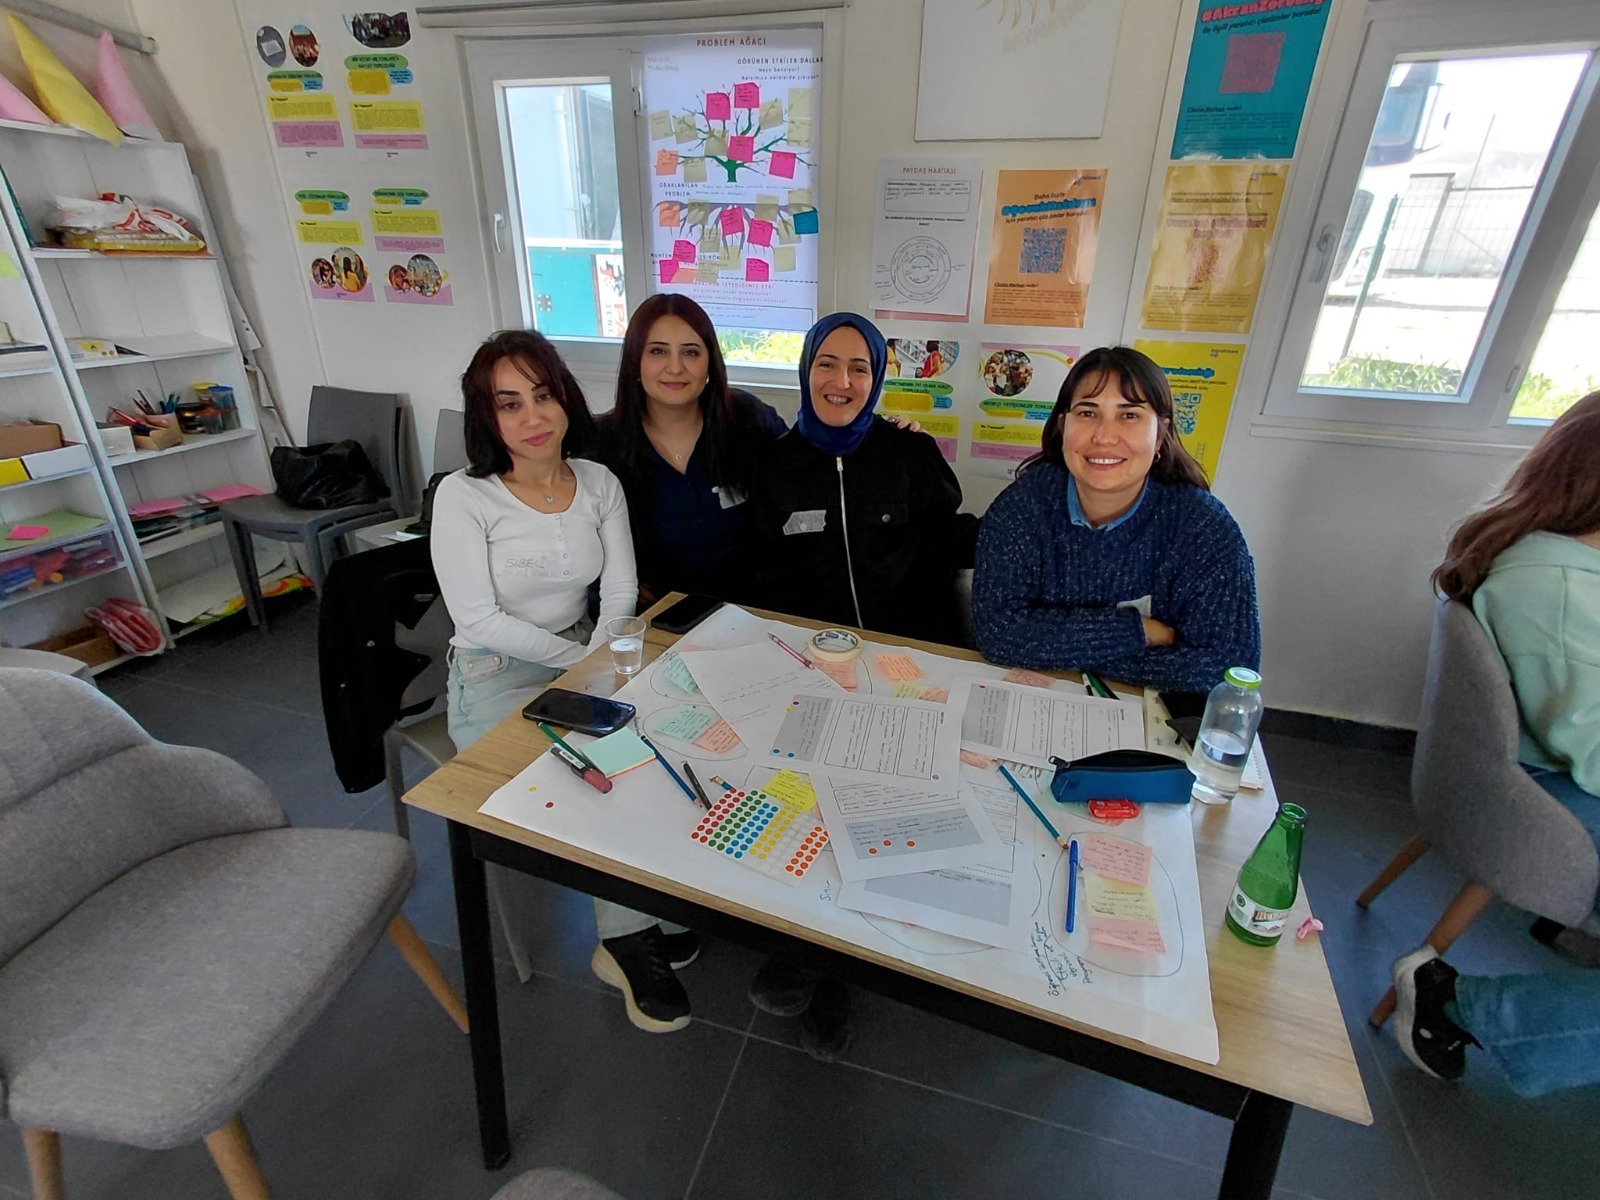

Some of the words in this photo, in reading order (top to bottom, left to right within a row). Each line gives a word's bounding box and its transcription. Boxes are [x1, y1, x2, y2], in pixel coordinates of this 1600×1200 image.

[1201, 0, 1325, 22] #AkranZorb
[696, 39, 735, 47] PROBLEM
[739, 36, 767, 46] AĞACI
[902, 167, 926, 175] PAYDAŞ
